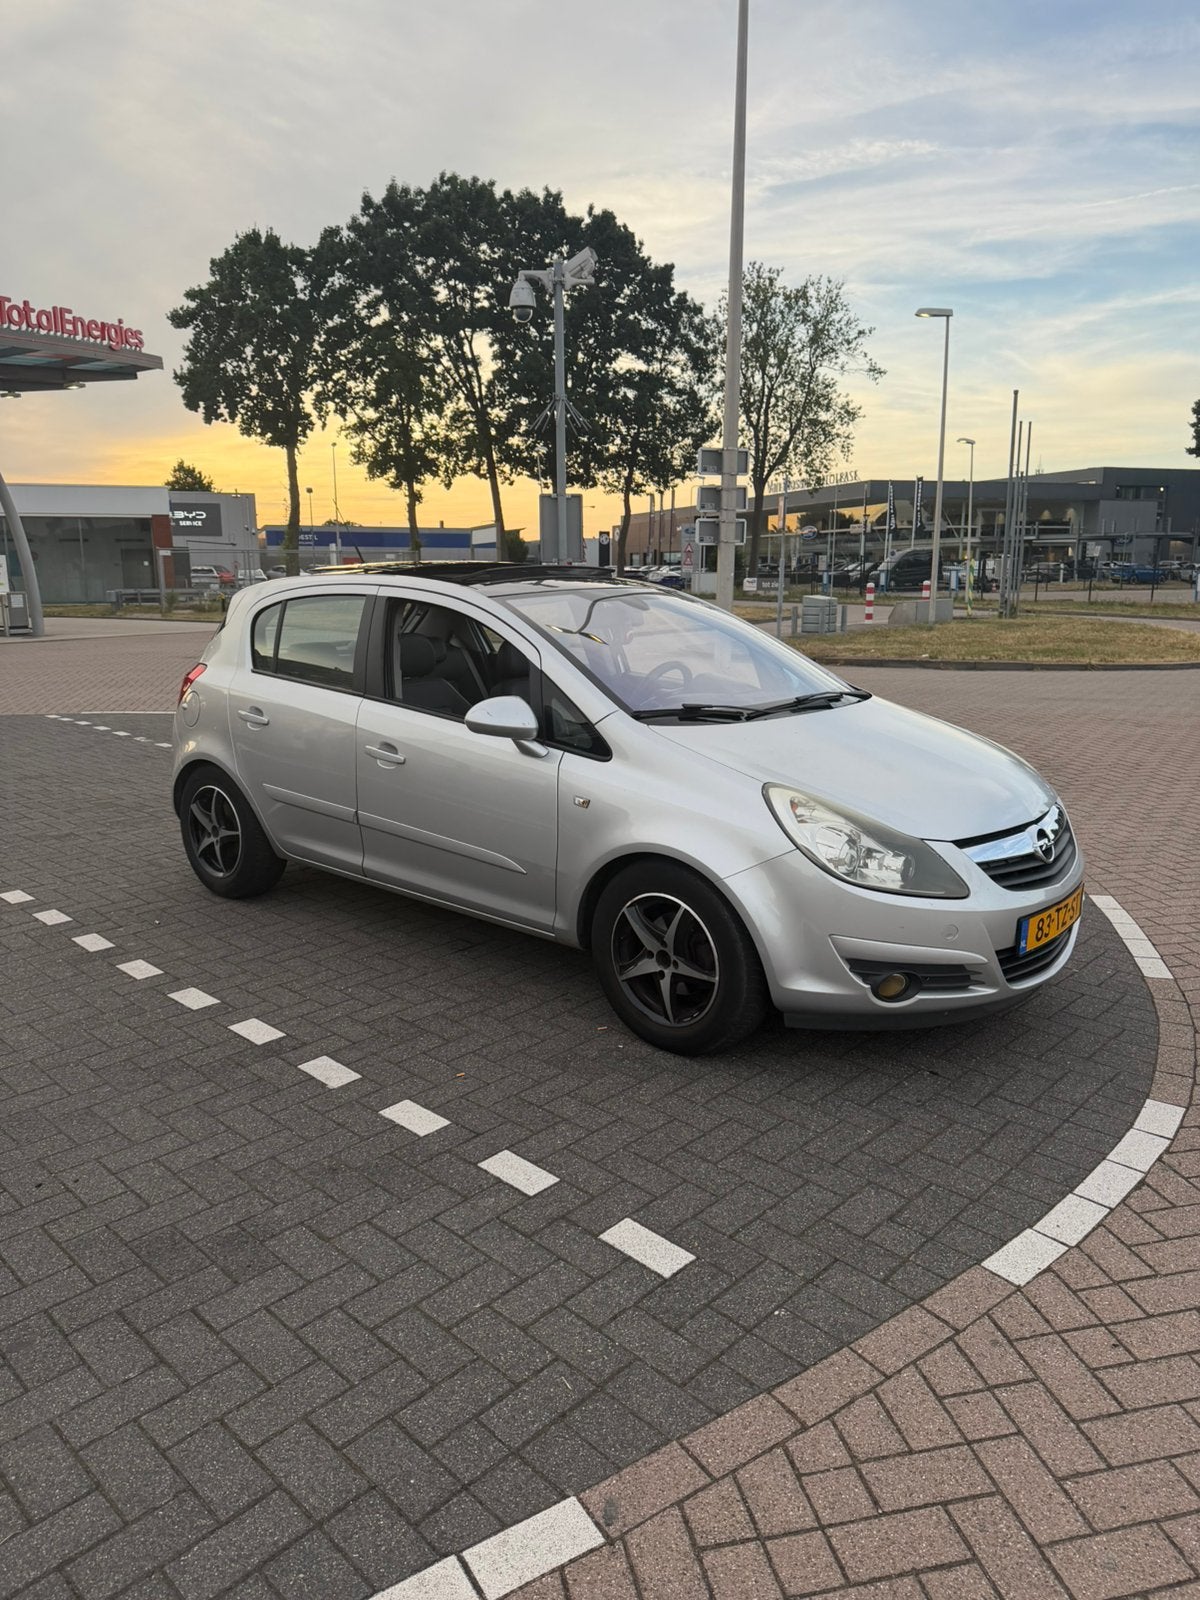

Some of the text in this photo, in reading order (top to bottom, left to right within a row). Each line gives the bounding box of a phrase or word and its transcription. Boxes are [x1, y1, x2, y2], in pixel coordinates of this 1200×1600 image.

[0, 295, 145, 351] TotalEnergies
[173, 510, 207, 519] BYD
[1035, 893, 1080, 942] 83-TZ-ST
